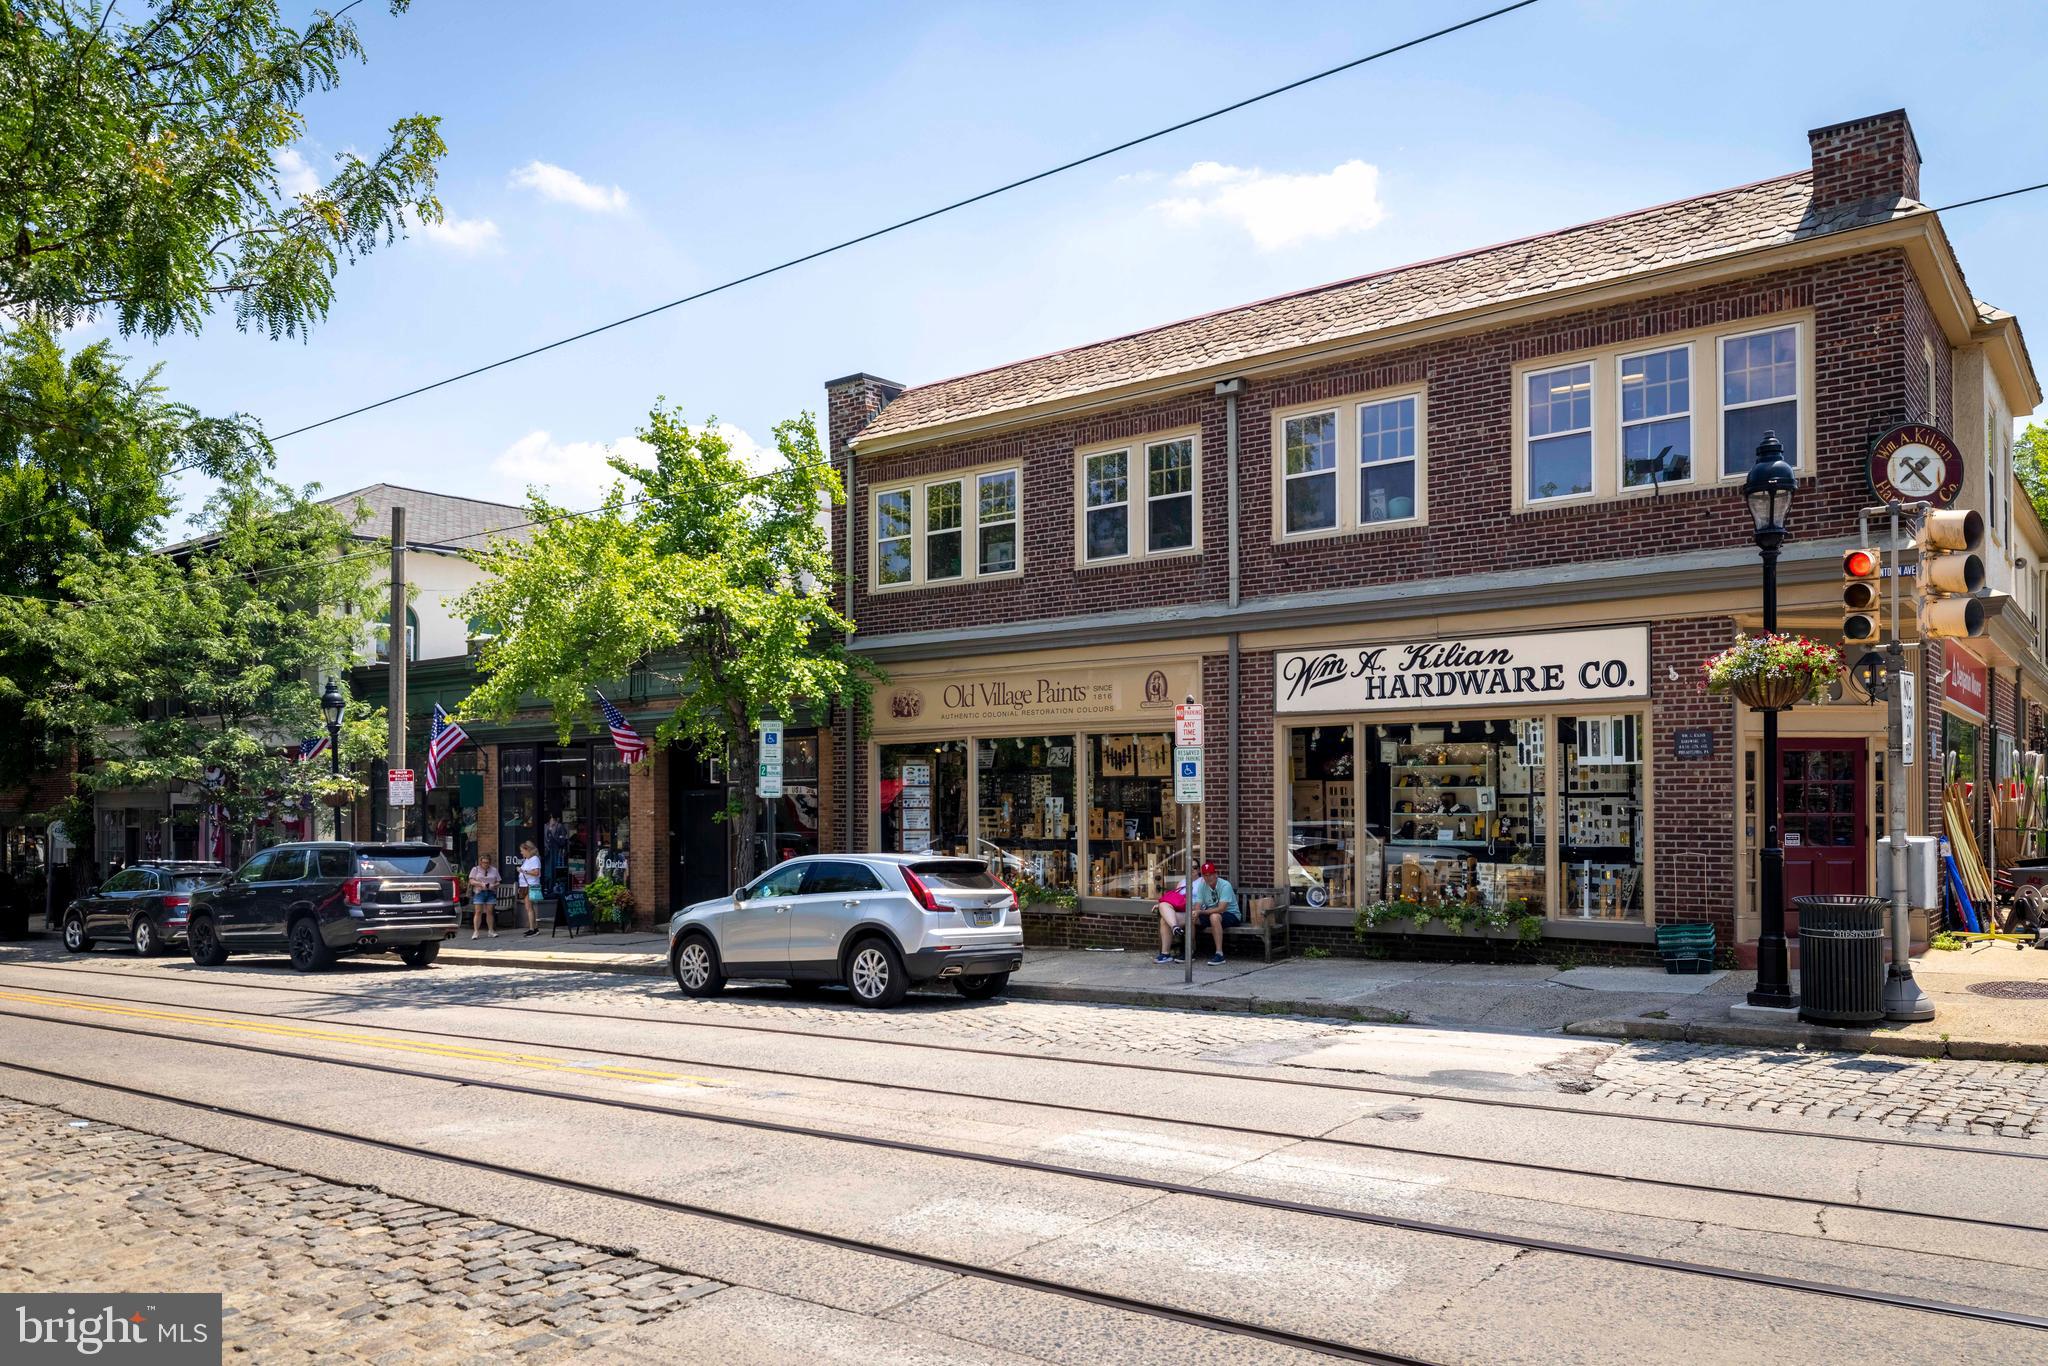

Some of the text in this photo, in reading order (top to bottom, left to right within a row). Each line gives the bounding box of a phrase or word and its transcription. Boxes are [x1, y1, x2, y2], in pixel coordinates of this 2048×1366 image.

[1900, 431, 1913, 446] A.
[1914, 427, 1953, 462] Kilian
[1350, 648, 1387, 678] A.
[1398, 642, 1514, 672] Kilian
[1092, 684, 1113, 692] SINCE
[1364, 659, 1635, 701] HARDWARE CO.
[943, 679, 1087, 711] Old Village Paints
[941, 705, 1114, 720] AUTHENTIC COLONIAL RESTORATION COLOURS
[761, 766, 766, 776] 2
[505, 856, 512, 865] El
